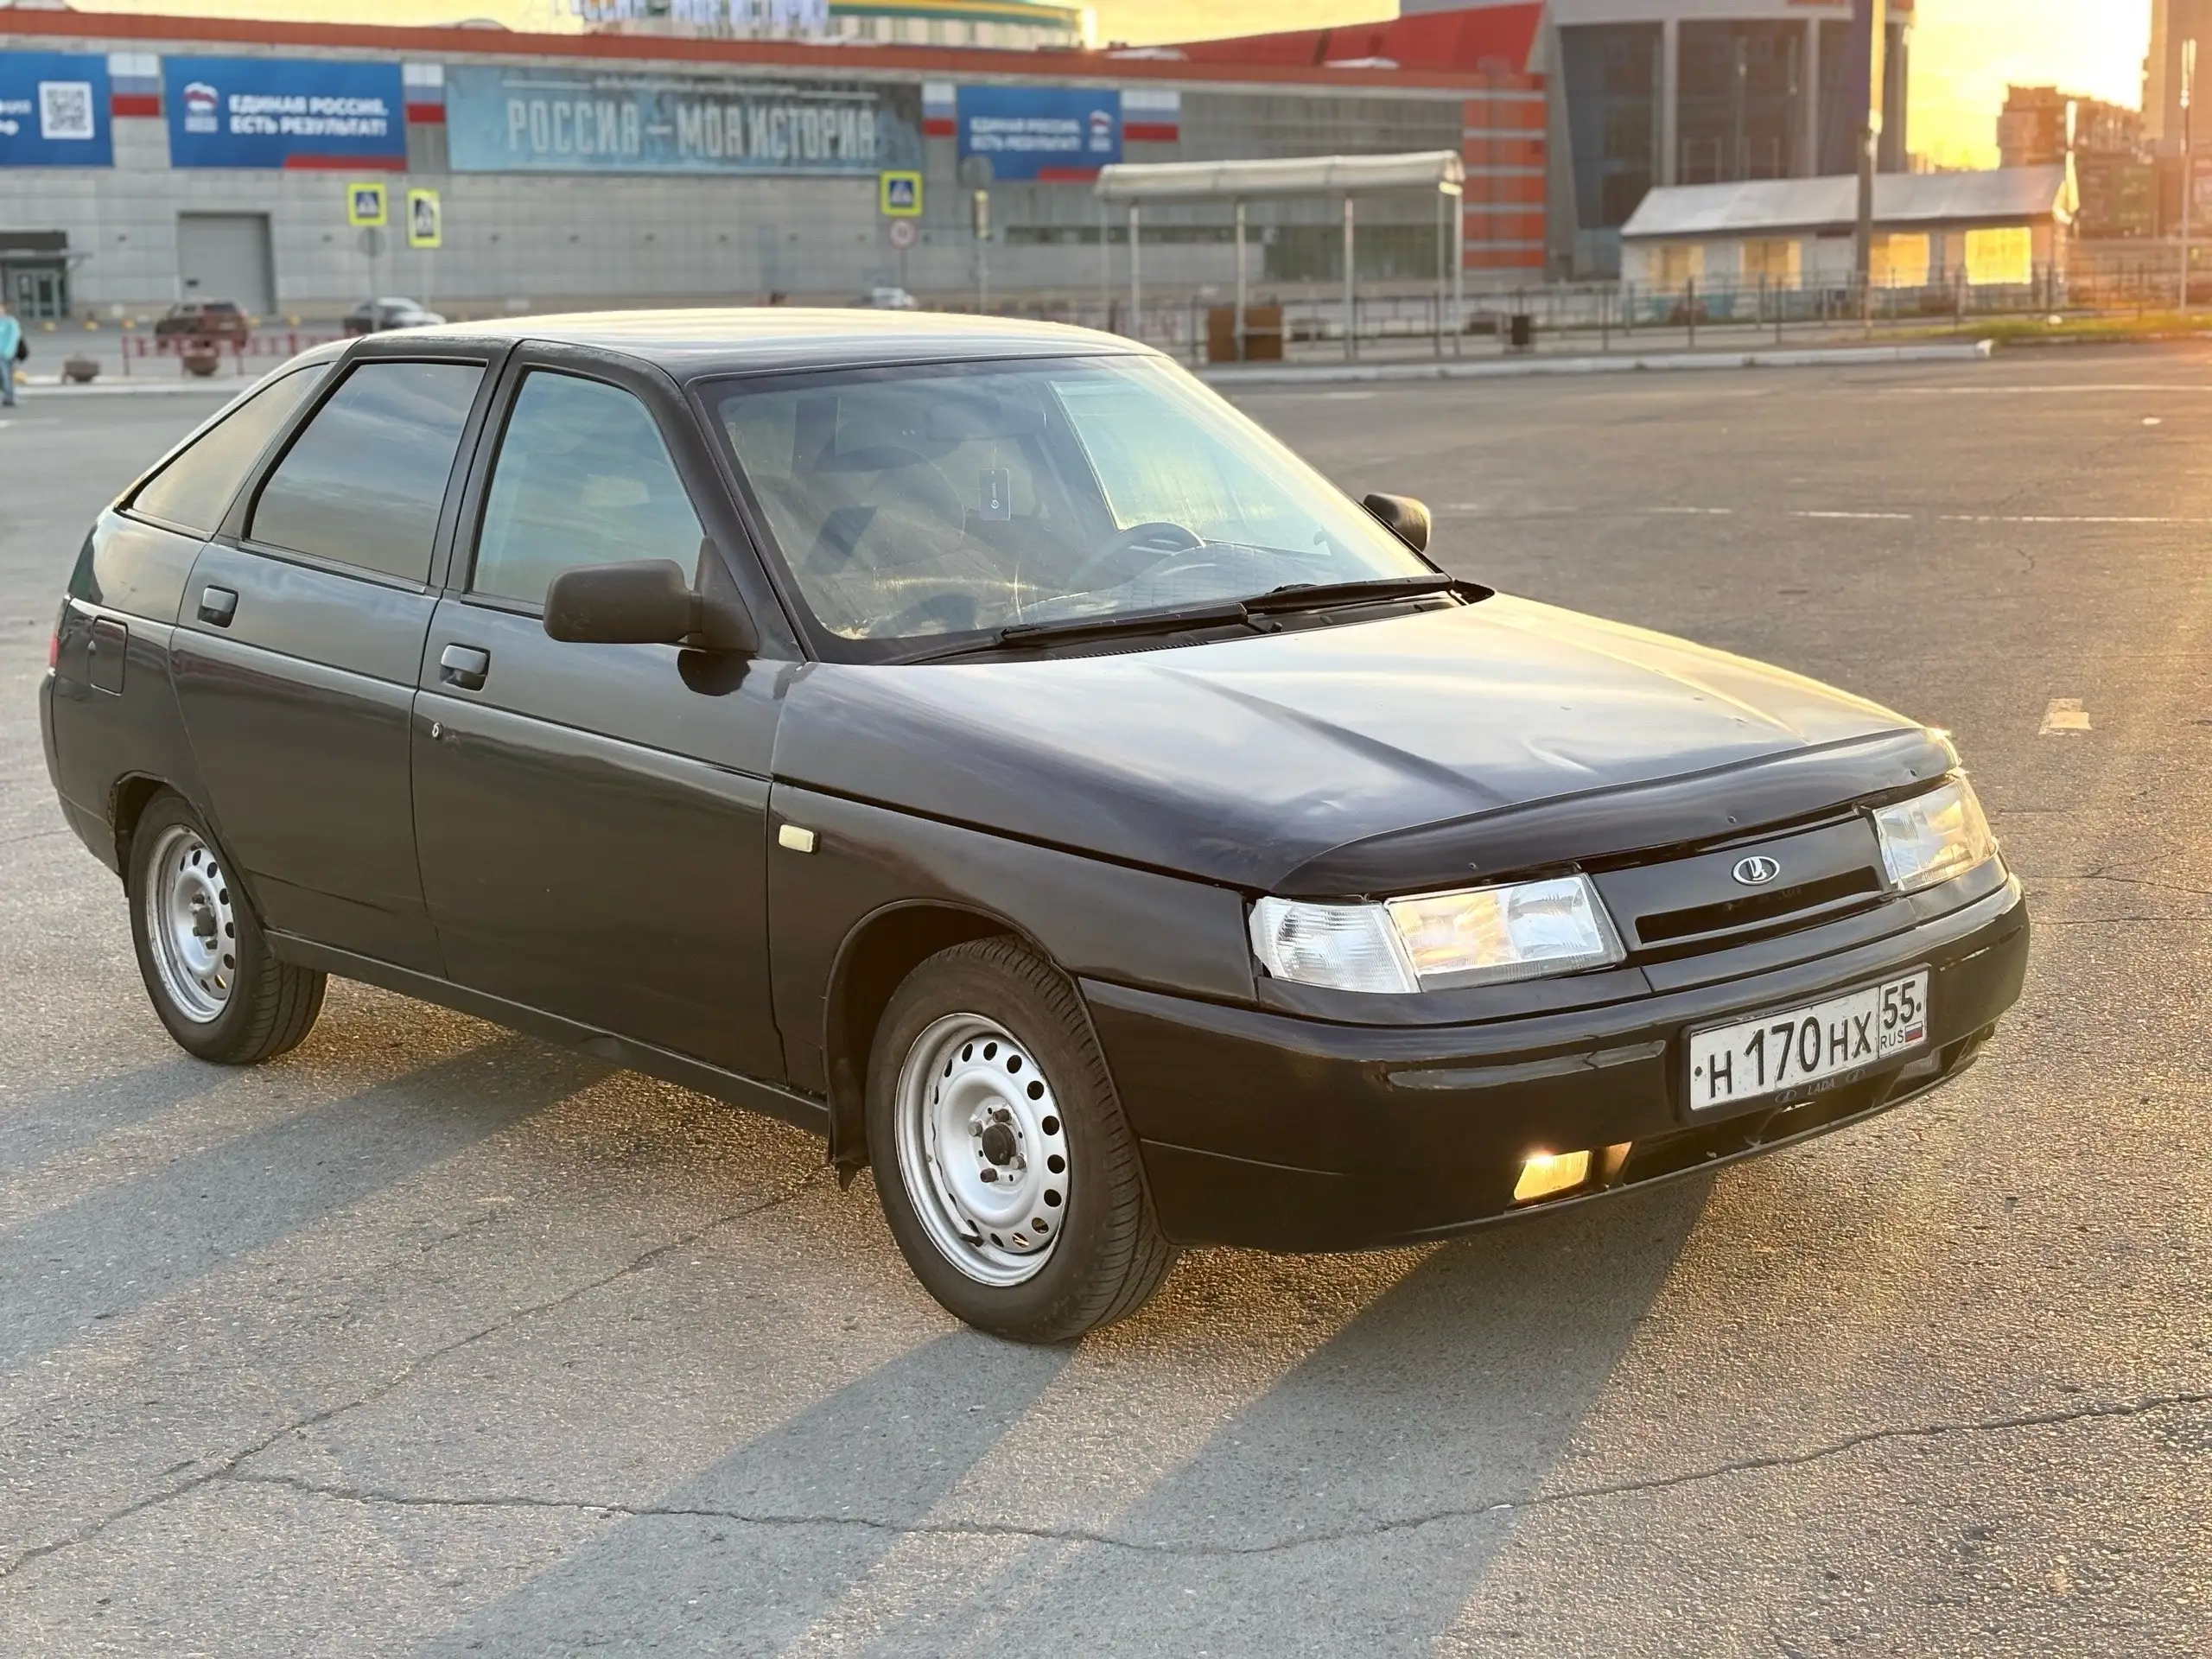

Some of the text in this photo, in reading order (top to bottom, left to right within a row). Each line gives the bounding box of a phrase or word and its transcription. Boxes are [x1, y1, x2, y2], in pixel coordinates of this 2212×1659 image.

[228, 94, 307, 114] ЕДИНАЯ
[230, 114, 278, 135] ЕСТЬ
[280, 116, 388, 137] РЕЗУЛЬТАТ!
[506, 98, 640, 156] РОССИЯ
[677, 101, 743, 159] МОЯ
[747, 104, 877, 161] ИСТОРИЯ
[1881, 978, 1916, 1030] 55
[1879, 1029, 1905, 1051] RUS
[1807, 1078, 1836, 1096] LADA
